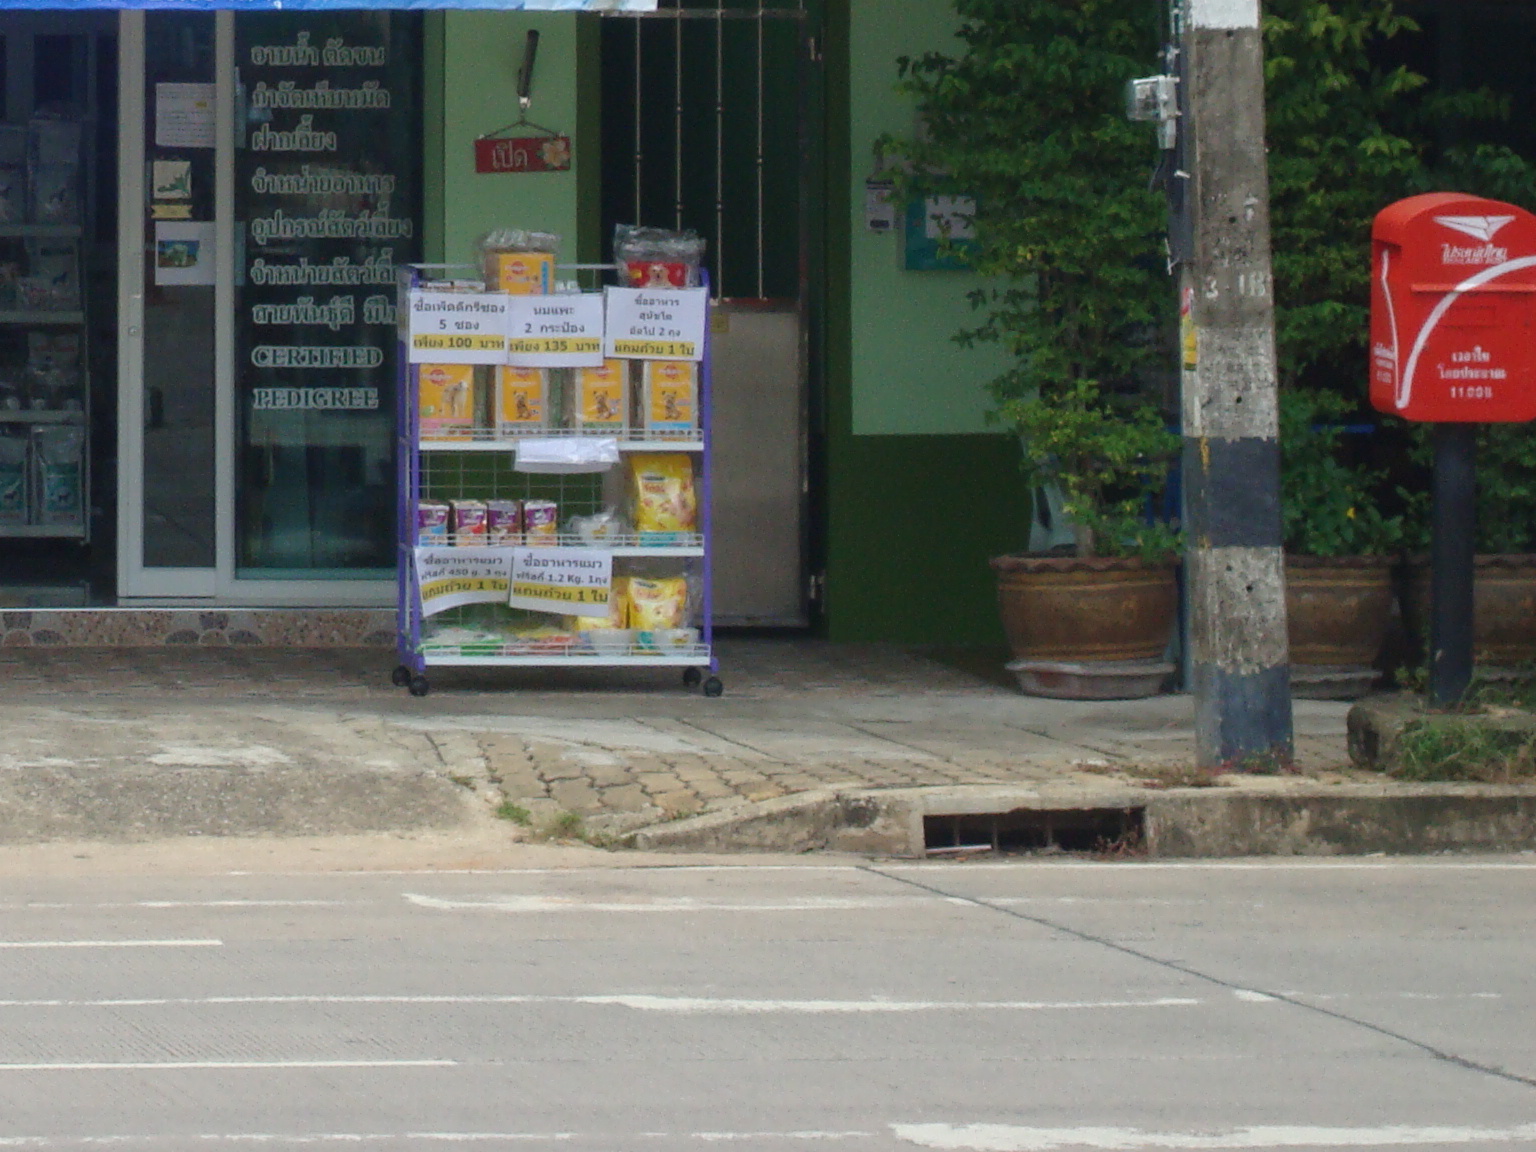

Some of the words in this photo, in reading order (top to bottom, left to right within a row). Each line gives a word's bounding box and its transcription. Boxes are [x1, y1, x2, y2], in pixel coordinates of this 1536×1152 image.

[491, 140, 528, 168] เปิด
[439, 319, 447, 330] 5
[524, 323, 533, 333] 2
[447, 337, 473, 349] 100
[544, 340, 568, 352] 135
[669, 345, 675, 355] 1
[251, 347, 383, 368] CERTIFIED
[253, 387, 379, 410] PEDIGREE
[548, 573, 564, 582] 1.2
[476, 580, 484, 590] 1
[577, 591, 585, 602] 1
